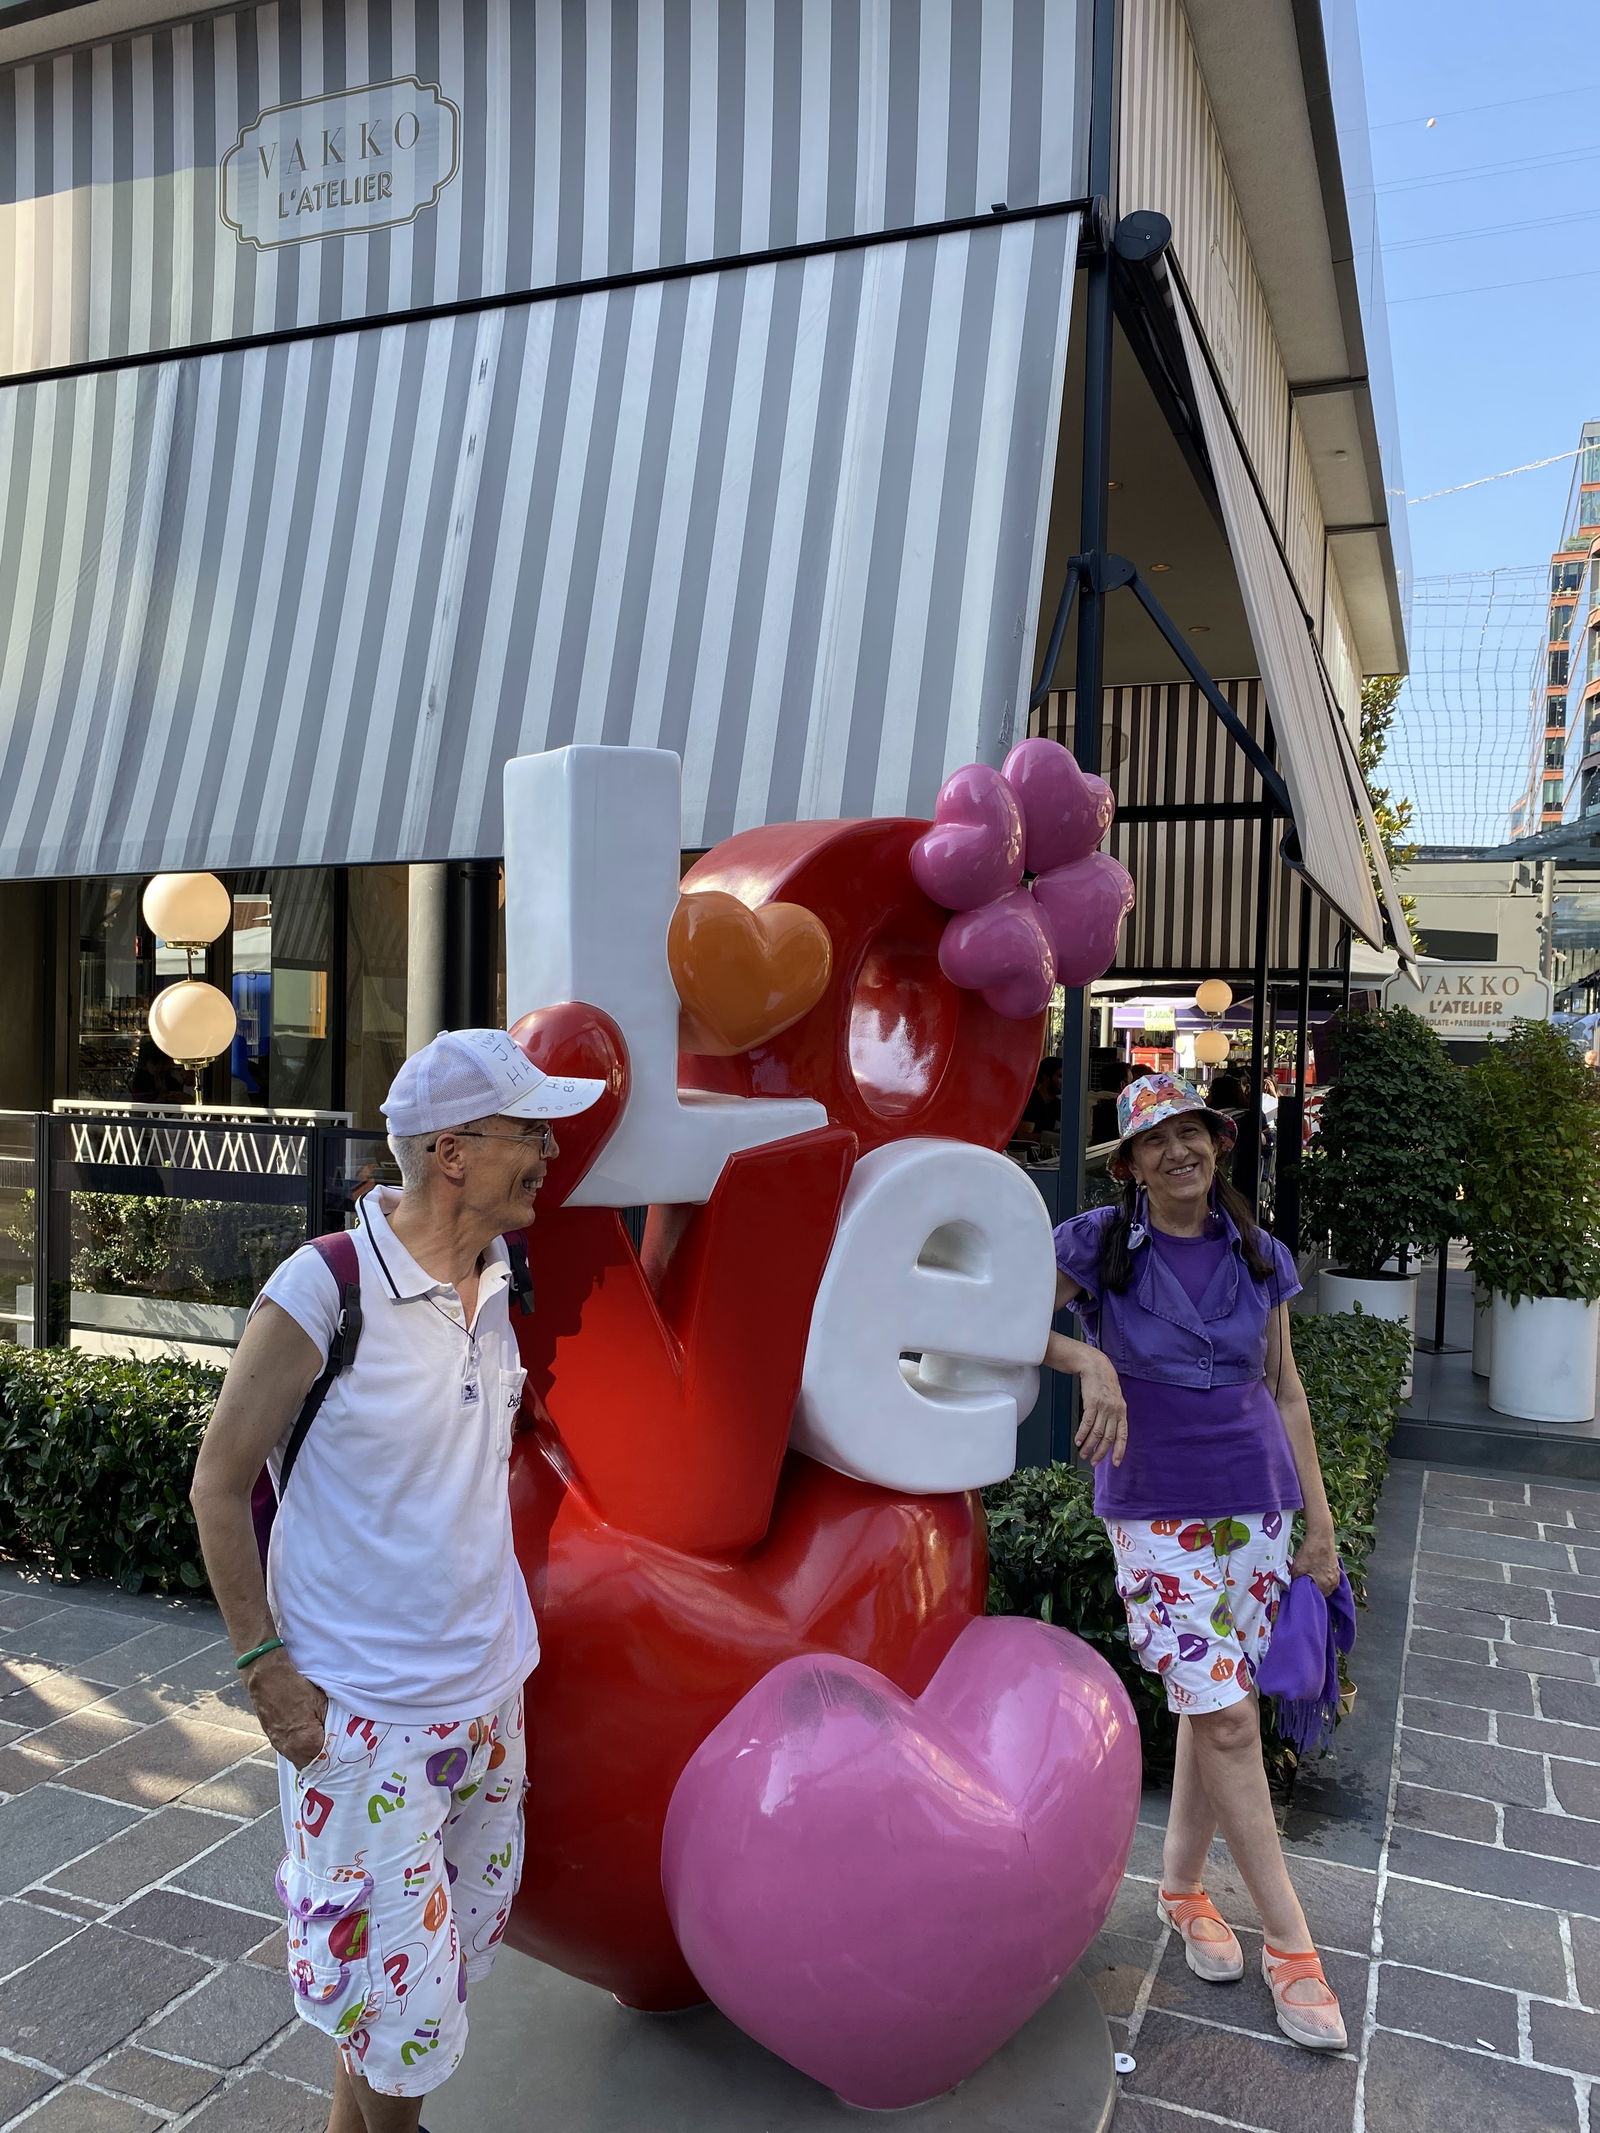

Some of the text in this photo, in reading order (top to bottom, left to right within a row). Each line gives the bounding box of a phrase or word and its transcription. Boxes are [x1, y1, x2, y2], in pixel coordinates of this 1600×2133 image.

[256, 111, 420, 180] VAKKO
[277, 170, 394, 220] L'ATELIER
[1419, 975, 1520, 996] VAKKO
[1429, 1000, 1503, 1015] L'ATELIER
